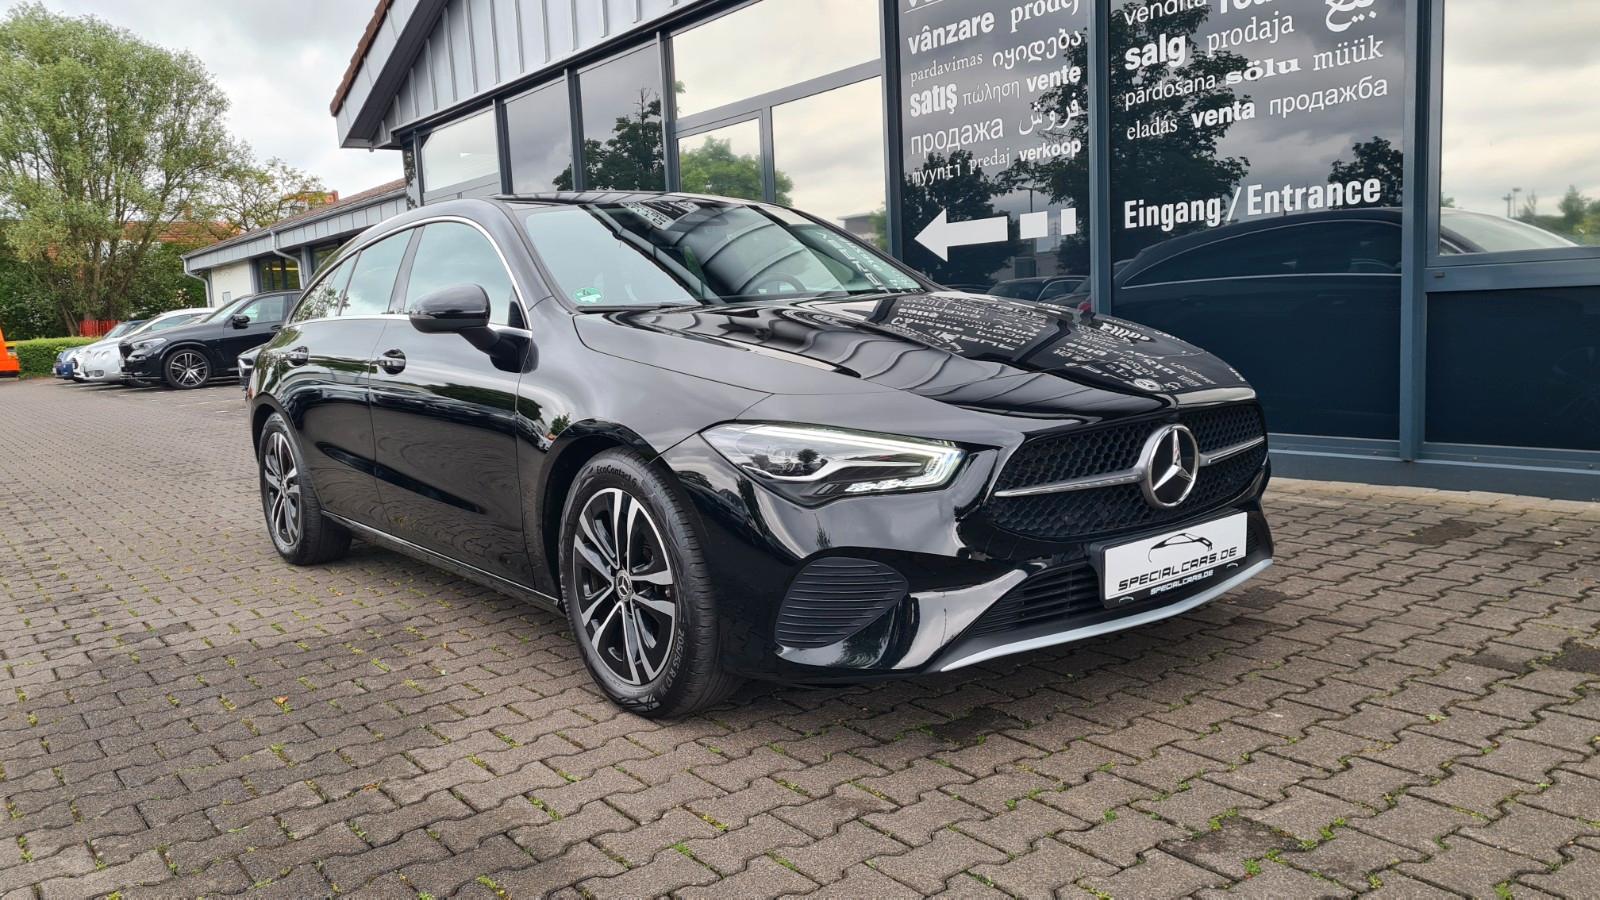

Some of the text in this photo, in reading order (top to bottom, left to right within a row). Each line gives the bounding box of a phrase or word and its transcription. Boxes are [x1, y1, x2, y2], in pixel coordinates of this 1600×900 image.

[907, 11, 995, 55] vânzare
[1125, 10, 1295, 71] salg prodaja
[910, 53, 984, 87] pardavimas
[1026, 65, 1082, 93] vente
[1125, 34, 1385, 111] pārdošana sölu müük
[910, 83, 958, 118] satış
[962, 80, 1020, 107] πώληση
[1269, 75, 1388, 118] продажба
[911, 117, 1004, 159] продажа
[1126, 100, 1256, 140] eladás venta
[912, 140, 1082, 187] myynti predaj verkoop
[1124, 196, 1222, 232] Eingang
[1247, 177, 1382, 216] Entrance
